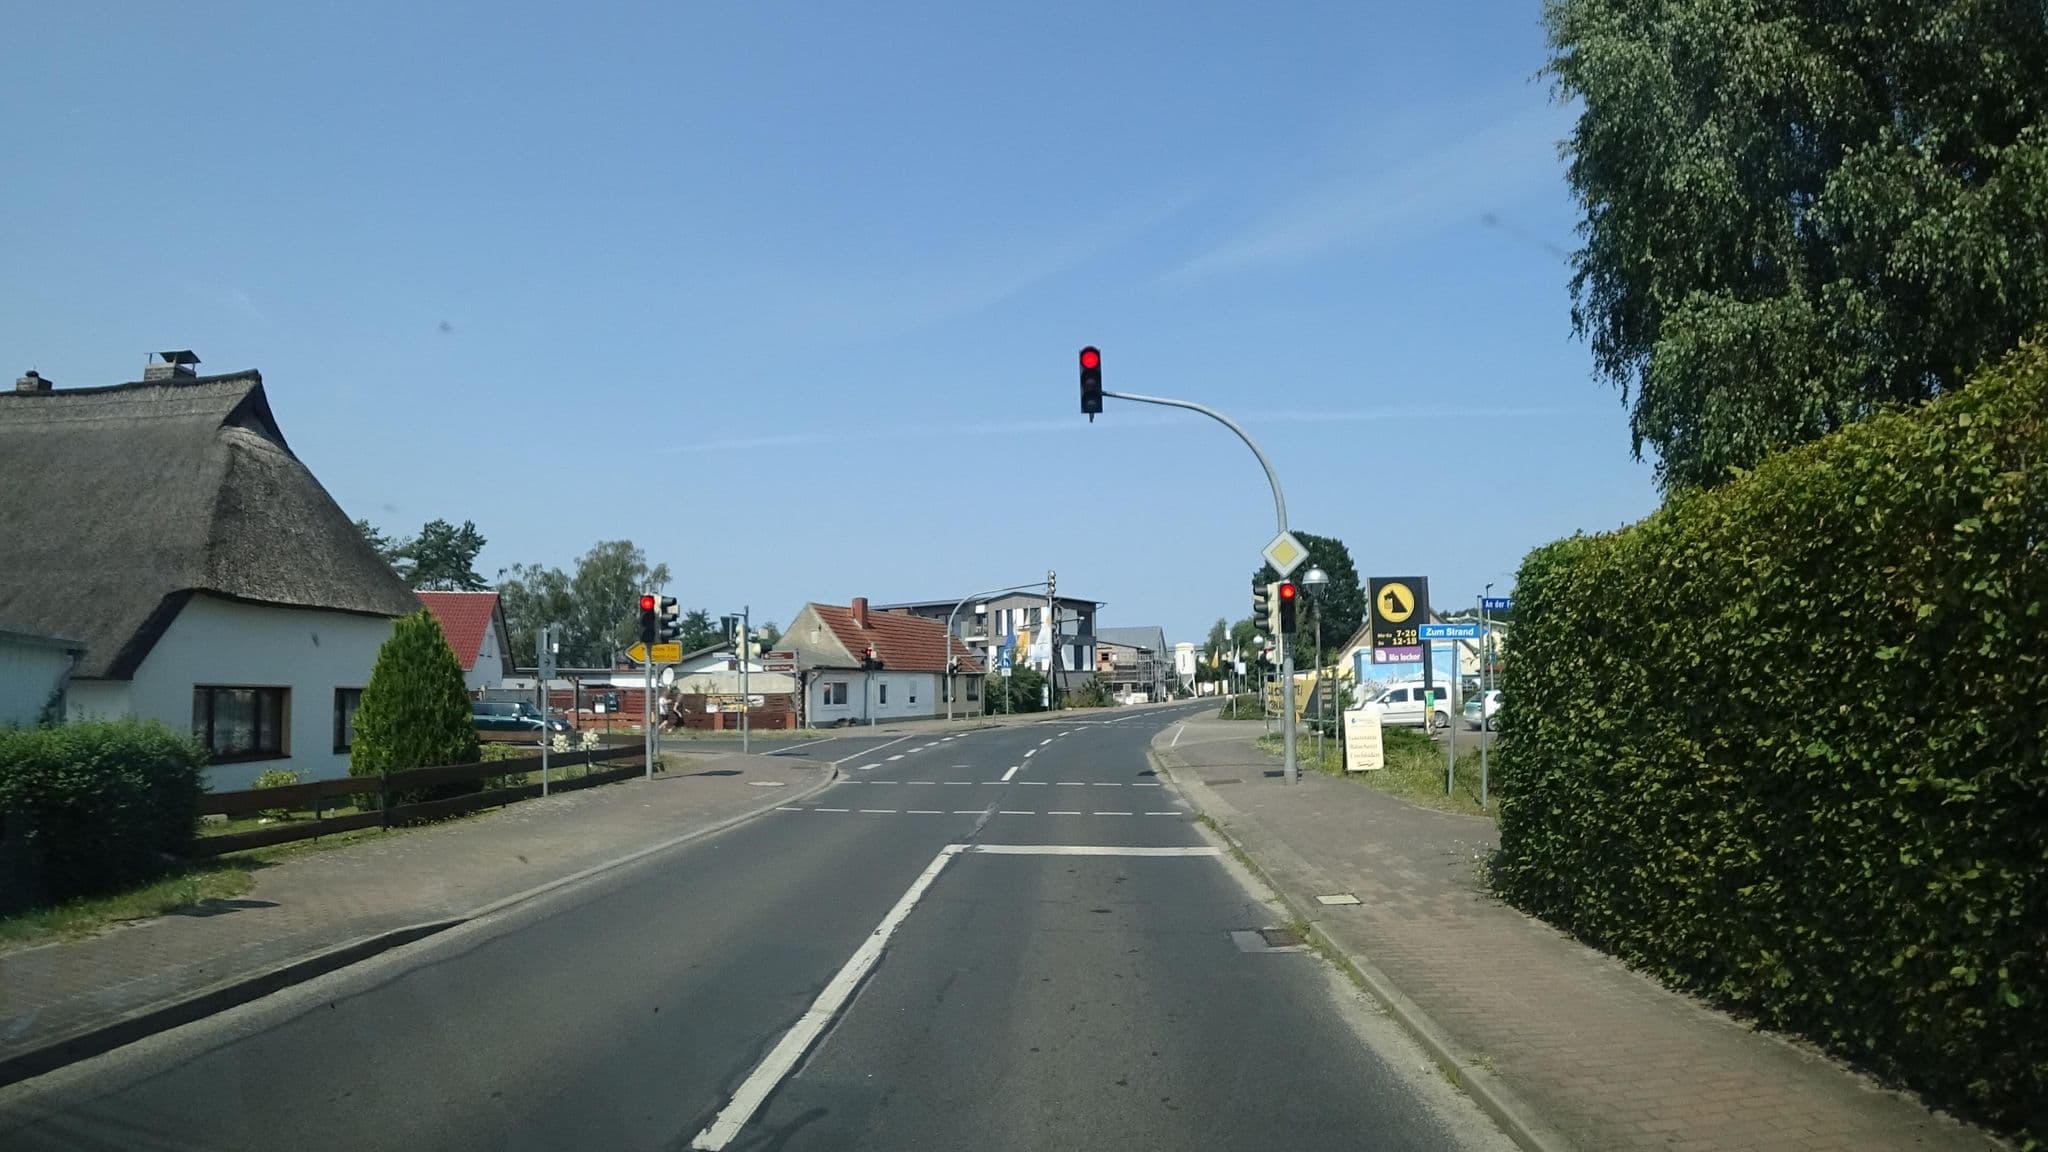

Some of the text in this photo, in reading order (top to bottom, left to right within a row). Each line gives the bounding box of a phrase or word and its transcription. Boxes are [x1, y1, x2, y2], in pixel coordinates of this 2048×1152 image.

[1485, 600, 1493, 608] An
[1495, 600, 1504, 608] der
[1426, 628, 1474, 636] Zum Strand
